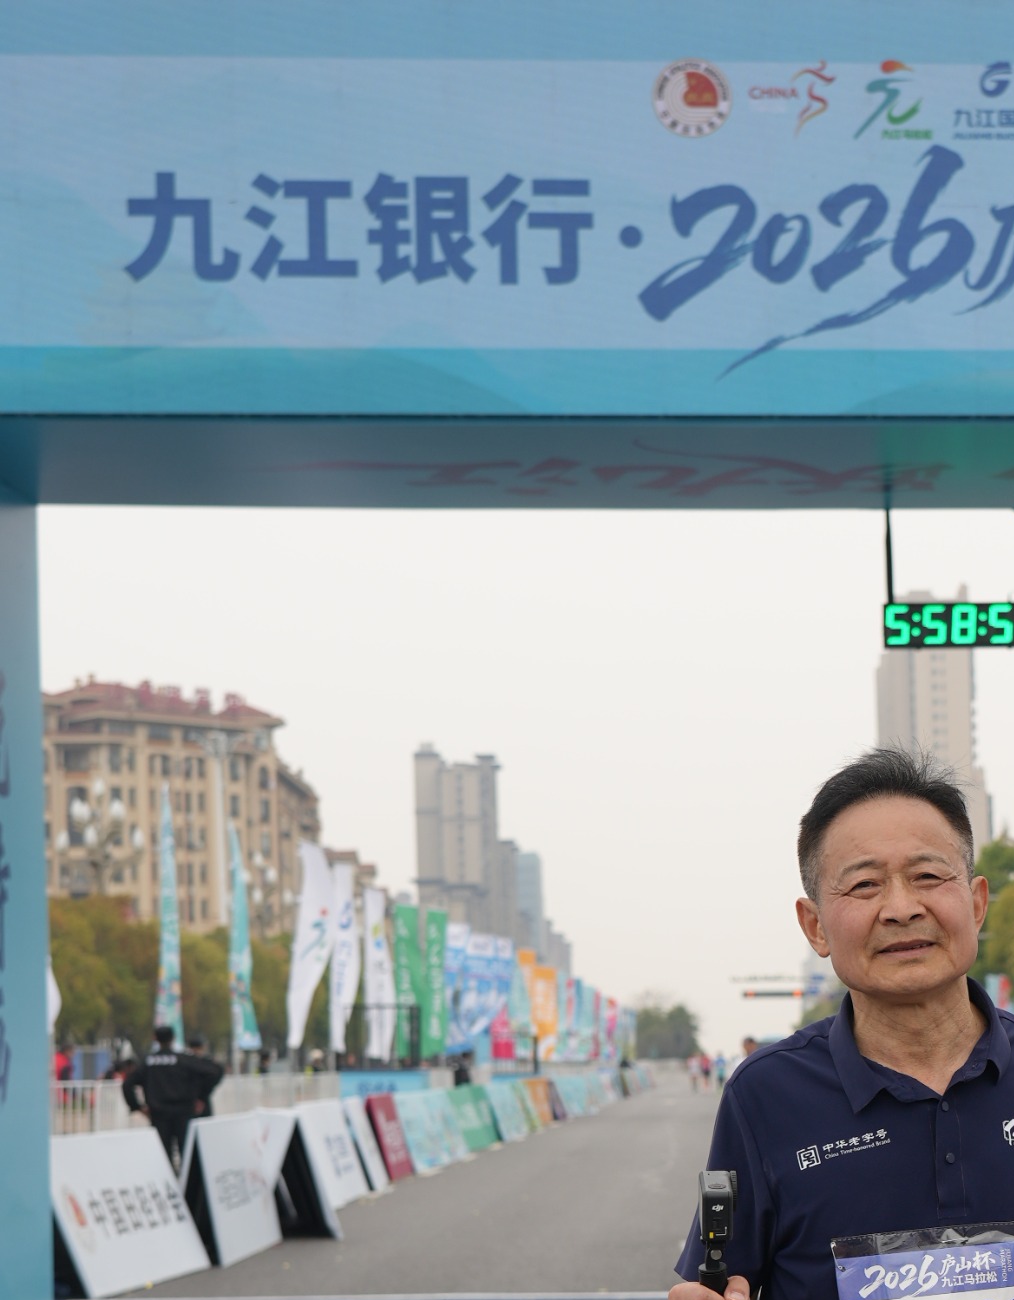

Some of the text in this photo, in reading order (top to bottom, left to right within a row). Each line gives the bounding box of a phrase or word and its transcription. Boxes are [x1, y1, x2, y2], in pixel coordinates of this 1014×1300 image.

[748, 86, 799, 100] CHINA
[822, 1128, 888, 1153] 中华老字号
[858, 1254, 939, 1299] 2026
[938, 1251, 996, 1278] 庐山杯
[941, 1271, 998, 1288] 九江马拉松
